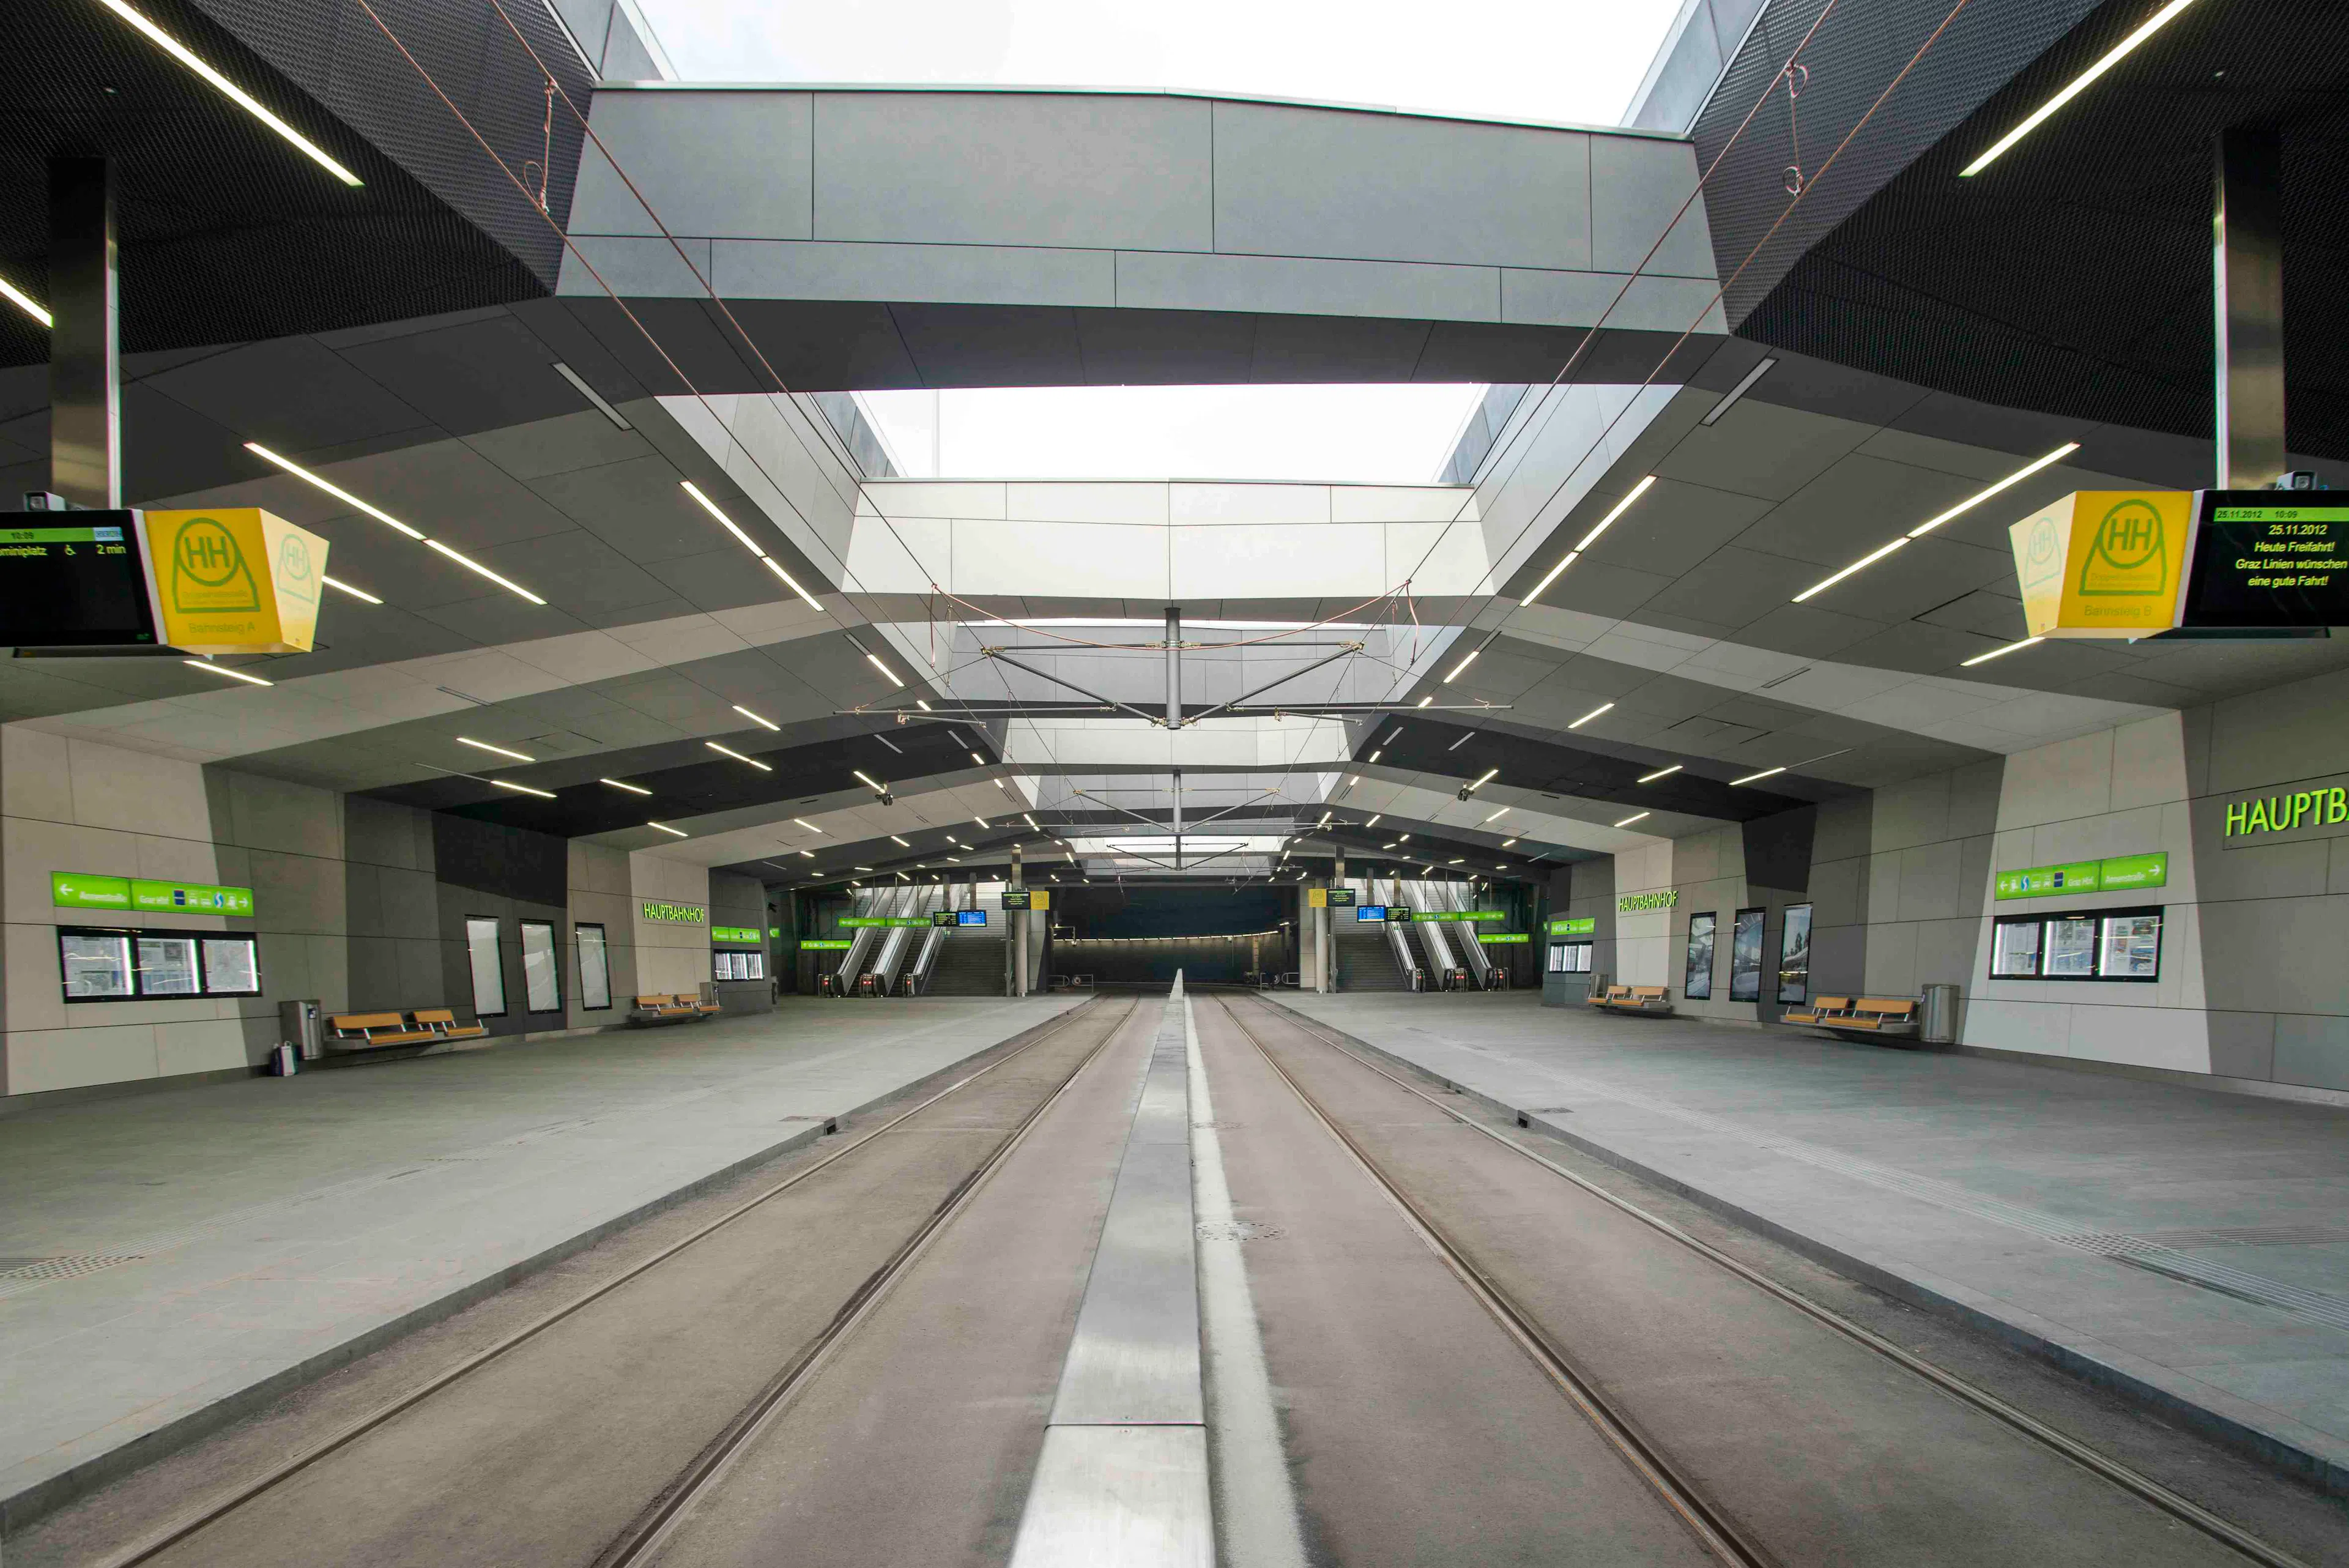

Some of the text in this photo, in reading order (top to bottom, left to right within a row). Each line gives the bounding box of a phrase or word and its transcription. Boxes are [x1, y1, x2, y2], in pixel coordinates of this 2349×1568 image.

[2108, 519, 2152, 551] HH
[2268, 524, 2328, 535] 25.11.2012
[95, 544, 106, 554] 2
[106, 544, 127, 554] min
[185, 537, 230, 568] HH
[2254, 541, 2335, 552] Heute Freifahrt!
[2235, 559, 2348, 570] Graz Linien wünschen
[2247, 576, 2329, 588] eine gute Fahrt!
[2225, 787, 2349, 836] HAUPTB
[1619, 891, 1678, 912] HAUPTBAHNHOF
[644, 903, 704, 923] HAUPTBAHNHOF
